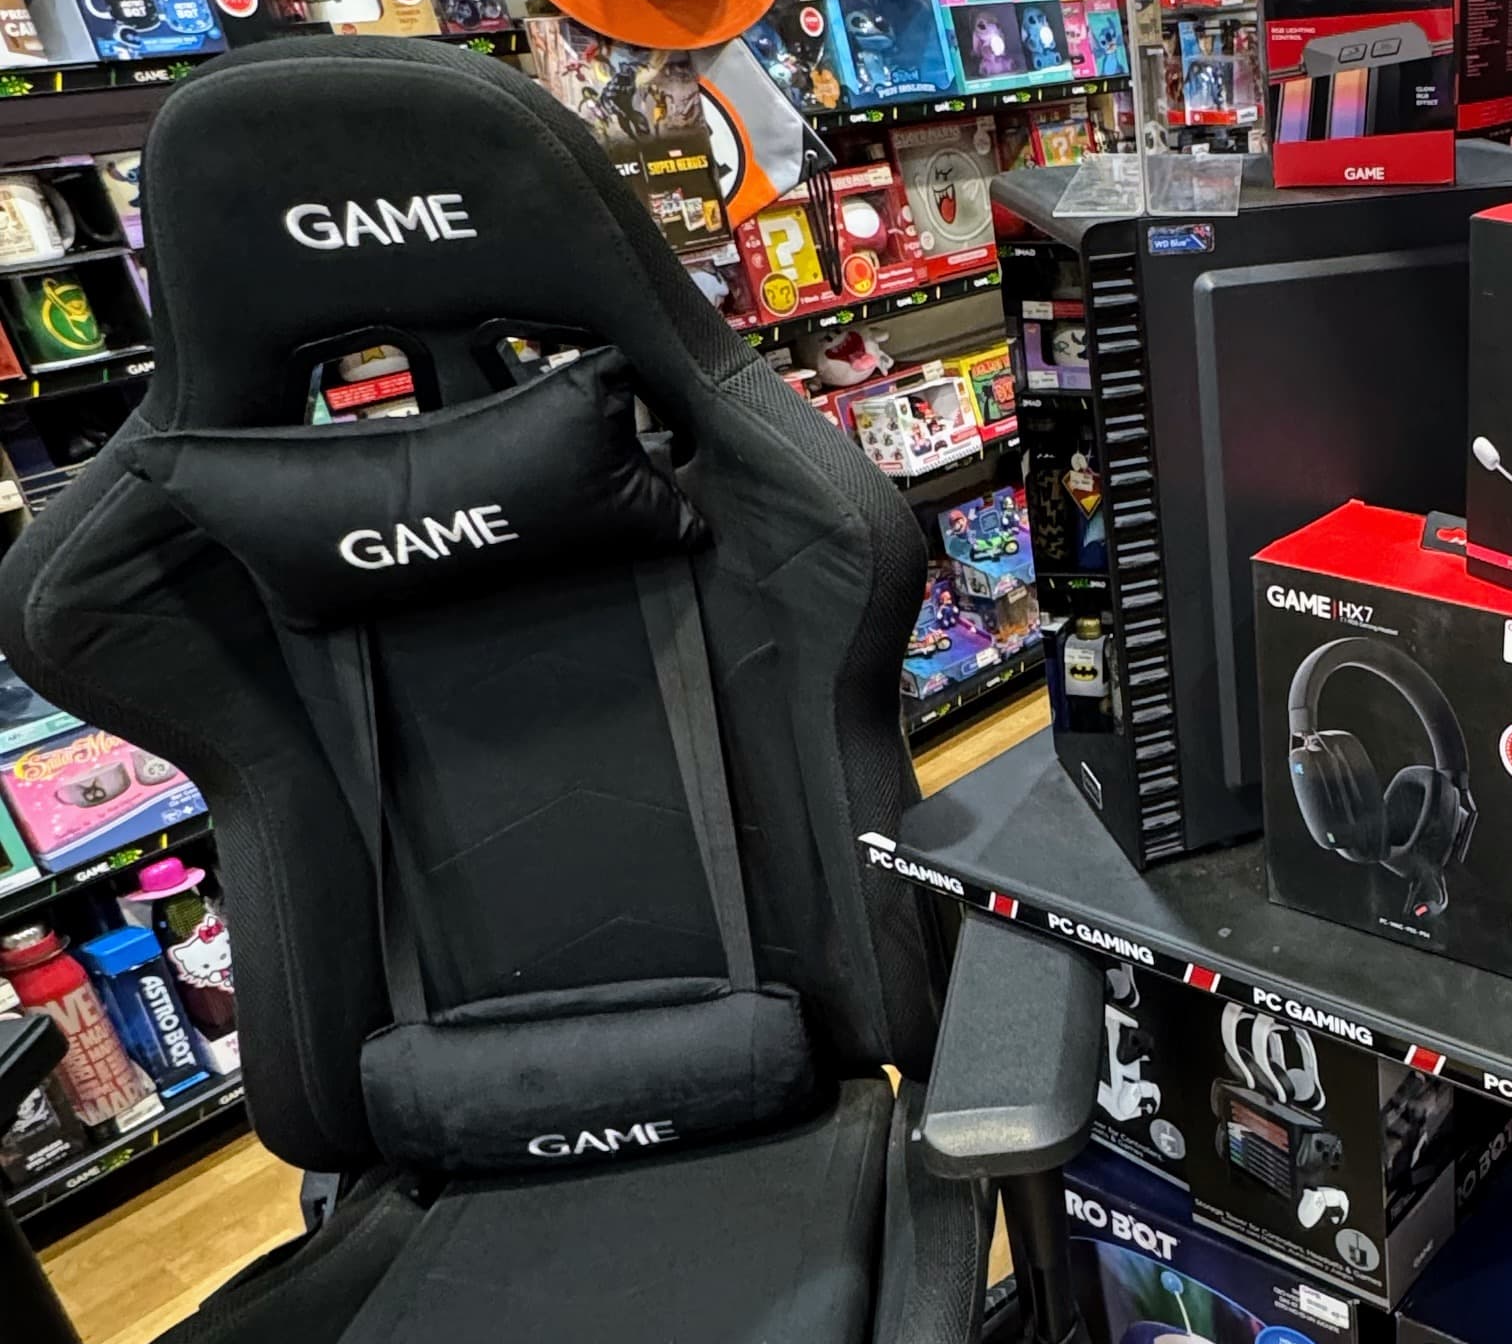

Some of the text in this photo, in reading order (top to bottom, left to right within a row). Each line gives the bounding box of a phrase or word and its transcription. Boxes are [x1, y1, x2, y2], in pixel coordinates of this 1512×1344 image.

[134, 70, 171, 82] GAME
[648, 155, 709, 176] SUPER HEROES
[1344, 167, 1385, 181] GAME
[284, 193, 478, 250] GAME
[339, 504, 520, 571] GAME
[1267, 585, 1374, 623] GAME HX7
[75, 861, 111, 883] GAME
[869, 847, 895, 871] PC
[894, 856, 965, 896] GAMING
[1047, 912, 1074, 936] PC
[1076, 921, 1155, 966] GAMING
[1253, 986, 1283, 1012] PC
[1285, 998, 1374, 1048] GAMING
[140, 975, 198, 1068] ASTRO BOT
[527, 1119, 681, 1156] GAME
[67, 1166, 101, 1188] GAME
[1111, 1210, 1180, 1262] BOT
[1351, 1267, 1383, 1288] Games
